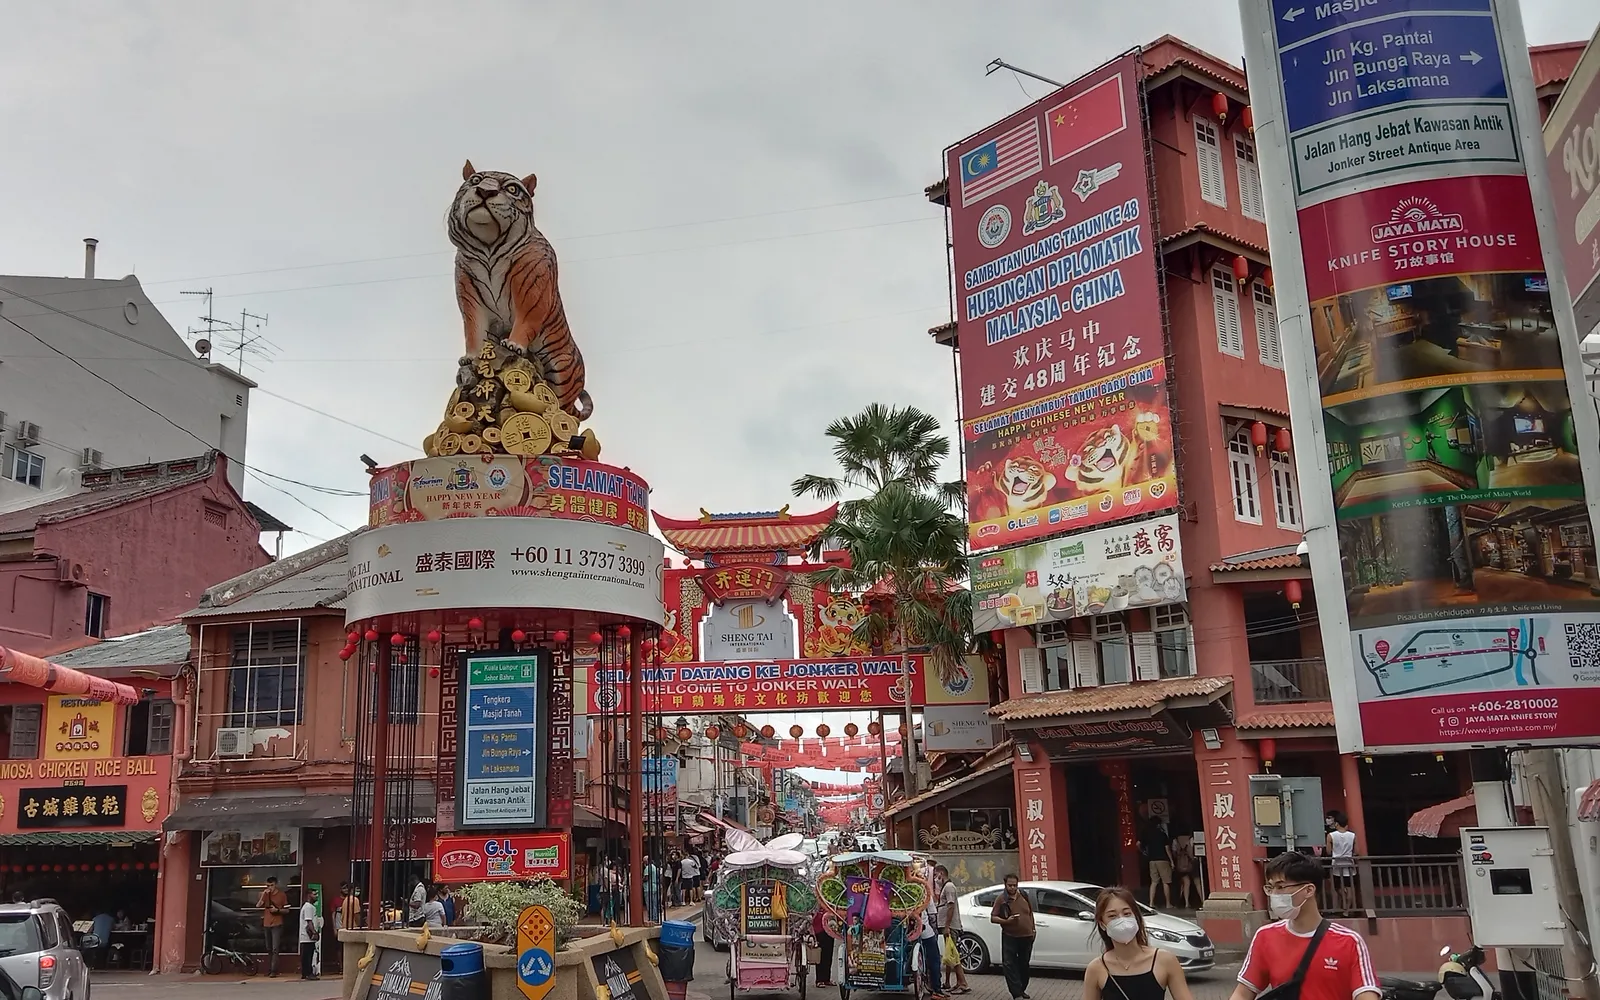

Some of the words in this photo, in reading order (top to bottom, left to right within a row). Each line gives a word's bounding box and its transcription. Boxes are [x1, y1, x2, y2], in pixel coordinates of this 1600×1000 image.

[1322, 46, 1346, 66] Jln
[1350, 38, 1378, 57] Kg.
[1383, 30, 1434, 49] Pantai
[1325, 67, 1349, 87] Jln
[1353, 55, 1408, 78] Bunga
[1412, 50, 1451, 67] Raya
[1328, 89, 1352, 108] Jln
[1356, 73, 1450, 99] Laksamana
[1303, 139, 1336, 162] Jalan
[1338, 130, 1371, 151] Hang
[1375, 119, 1410, 142] Jebat
[1413, 117, 1470, 134] Kawasan
[1474, 114, 1504, 131] Antik
[1327, 154, 1365, 174] Jonker
[1368, 145, 1405, 163] Street
[1408, 140, 1451, 157] Antique
[1454, 138, 1480, 152] Area
[1374, 222, 1415, 240] JAYA
[1417, 217, 1461, 234] MATA
[965, 250, 1022, 289] SAMBUTAN
[1023, 236, 1061, 264] ULANG
[1062, 220, 1102, 248] TAHUN
[1105, 211, 1122, 230] KE
[1123, 199, 1139, 222] 48
[1328, 248, 1381, 272] KNIFE
[1388, 239, 1450, 258] STORY
[1456, 234, 1518, 249] HOUSE
[1394, 252, 1455, 270] 刀故事馆
[966, 271, 1045, 321] HUBUNGAN
[1048, 226, 1142, 289] DIPLOMATIK
[986, 294, 1061, 346] MALAYSIA
[1071, 269, 1125, 313] CHINA
[974, 413, 1009, 434] SELAMAT
[1011, 395, 1067, 422] MENYAMBUT
[1068, 386, 1099, 404] TAHUN
[1100, 376, 1127, 394] BARU
[1128, 366, 1153, 386] CINA
[998, 423, 1027, 438] HAPPY
[1031, 409, 1070, 428] CHINESE
[1074, 403, 1095, 415] NEW
[1099, 392, 1125, 407] YEAR
[548, 465, 624, 499] SELAMAT
[427, 494, 451, 502] HAPPY
[455, 493, 474, 501] NEW
[476, 492, 501, 500] YEAR
[1392, 500, 1411, 509] Keris
[1493, 490, 1512, 499] Malay
[1512, 489, 1532, 497] World
[1007, 517, 1027, 531] G.L.
[415, 549, 495, 574] 盛泰國際
[511, 546, 548, 564] +60
[554, 548, 573, 565] 11
[579, 549, 615, 570] 3737
[618, 555, 645, 577] 3399
[973, 581, 1002, 591] TONGKAT
[1397, 614, 1417, 622] Pisau
[1418, 612, 1433, 620] dan
[1434, 607, 1475, 619] Kehidupan
[1512, 603, 1530, 611] Knife
[1530, 603, 1543, 611] and
[1543, 603, 1562, 612] Living
[721, 633, 755, 642] SHENG
[756, 632, 773, 641] TAI
[499, 664, 518, 672] Lumpur
[499, 673, 515, 681] Bahru
[681, 666, 752, 681] DATANG
[756, 665, 780, 680] KE
[784, 662, 859, 678] JONKER
[862, 661, 916, 676] WALK
[642, 683, 722, 695] WELCOME
[725, 682, 748, 693] TO
[752, 680, 817, 692] JONKER
[822, 678, 869, 690] WALK
[483, 696, 511, 706] Tengkera
[1431, 706, 1445, 715] Call
[1446, 707, 1456, 715] us
[1457, 706, 1466, 714] on
[1469, 698, 1559, 712] +606-2810002
[482, 710, 503, 720] Masjid
[504, 709, 522, 718] Tanah
[1466, 714, 1485, 724] JAYA
[1486, 713, 1510, 722] MATA
[1511, 713, 1533, 721] KNIFE
[1534, 712, 1558, 720] STORY
[1108, 720, 1169, 735] Gong
[1439, 723, 1557, 737] https://www.jayamata.com.my/
[481, 734, 490, 743] Jln
[501, 733, 518, 741] Pantai
[481, 750, 489, 758] Jln
[491, 749, 508, 758] Bunga
[508, 748, 522, 757] Raya
[38, 761, 88, 779] CHICKEN
[94, 760, 121, 777] RICE
[126, 759, 157, 776] BALL
[481, 765, 489, 773] Jln
[490, 765, 520, 773] Laksamana
[470, 786, 489, 795] Jalan
[491, 786, 510, 795] Hang
[511, 785, 530, 794] Jebat
[474, 797, 506, 805] Kawasan
[507, 796, 526, 804] Antik
[1210, 762, 1237, 850] 三叔公
[1024, 772, 1045, 850] 三叔公
[485, 840, 518, 856] G.L.
[749, 897, 772, 907] BEC
